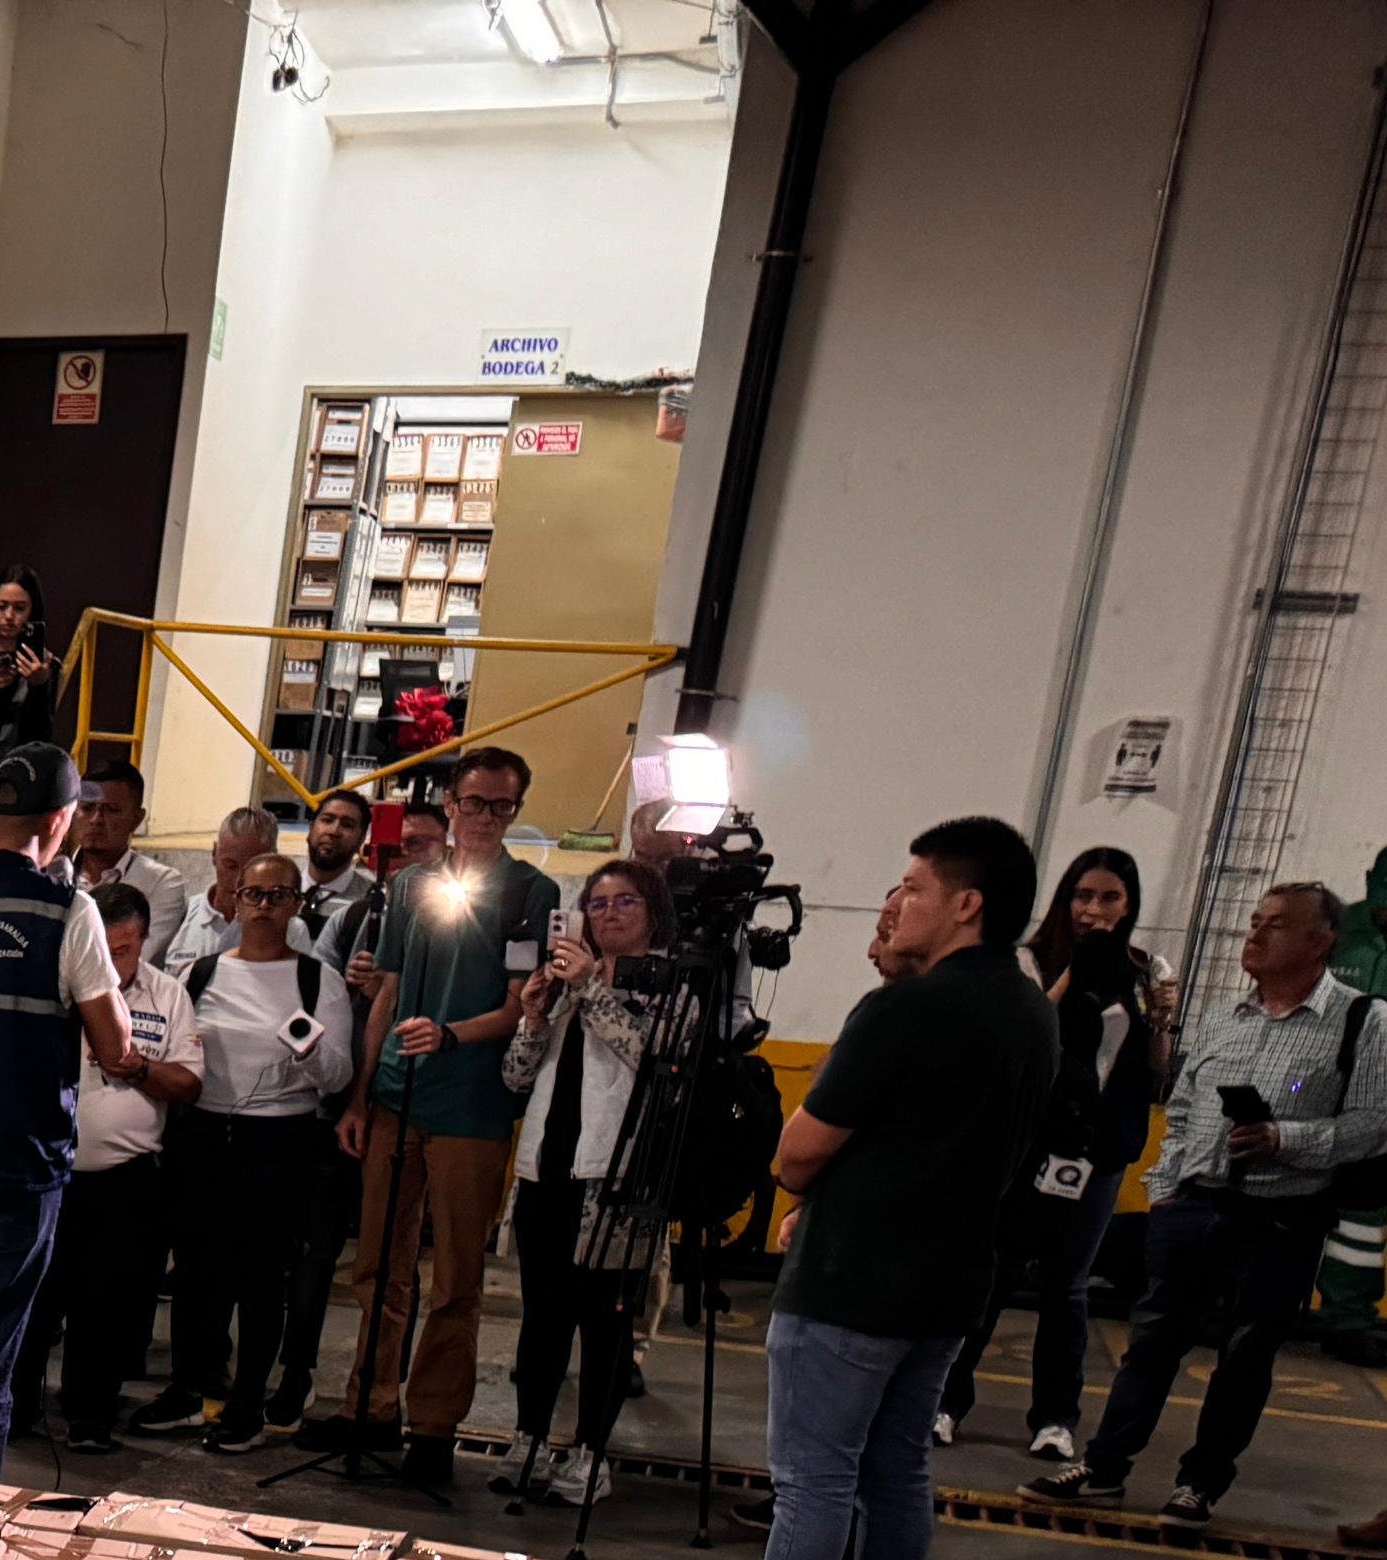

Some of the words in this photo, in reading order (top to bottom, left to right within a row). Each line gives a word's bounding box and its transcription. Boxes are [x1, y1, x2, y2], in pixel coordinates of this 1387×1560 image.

[488, 337, 559, 353] ARCHIVO
[481, 360, 545, 375] BODEGA
[550, 361, 559, 375] 2
